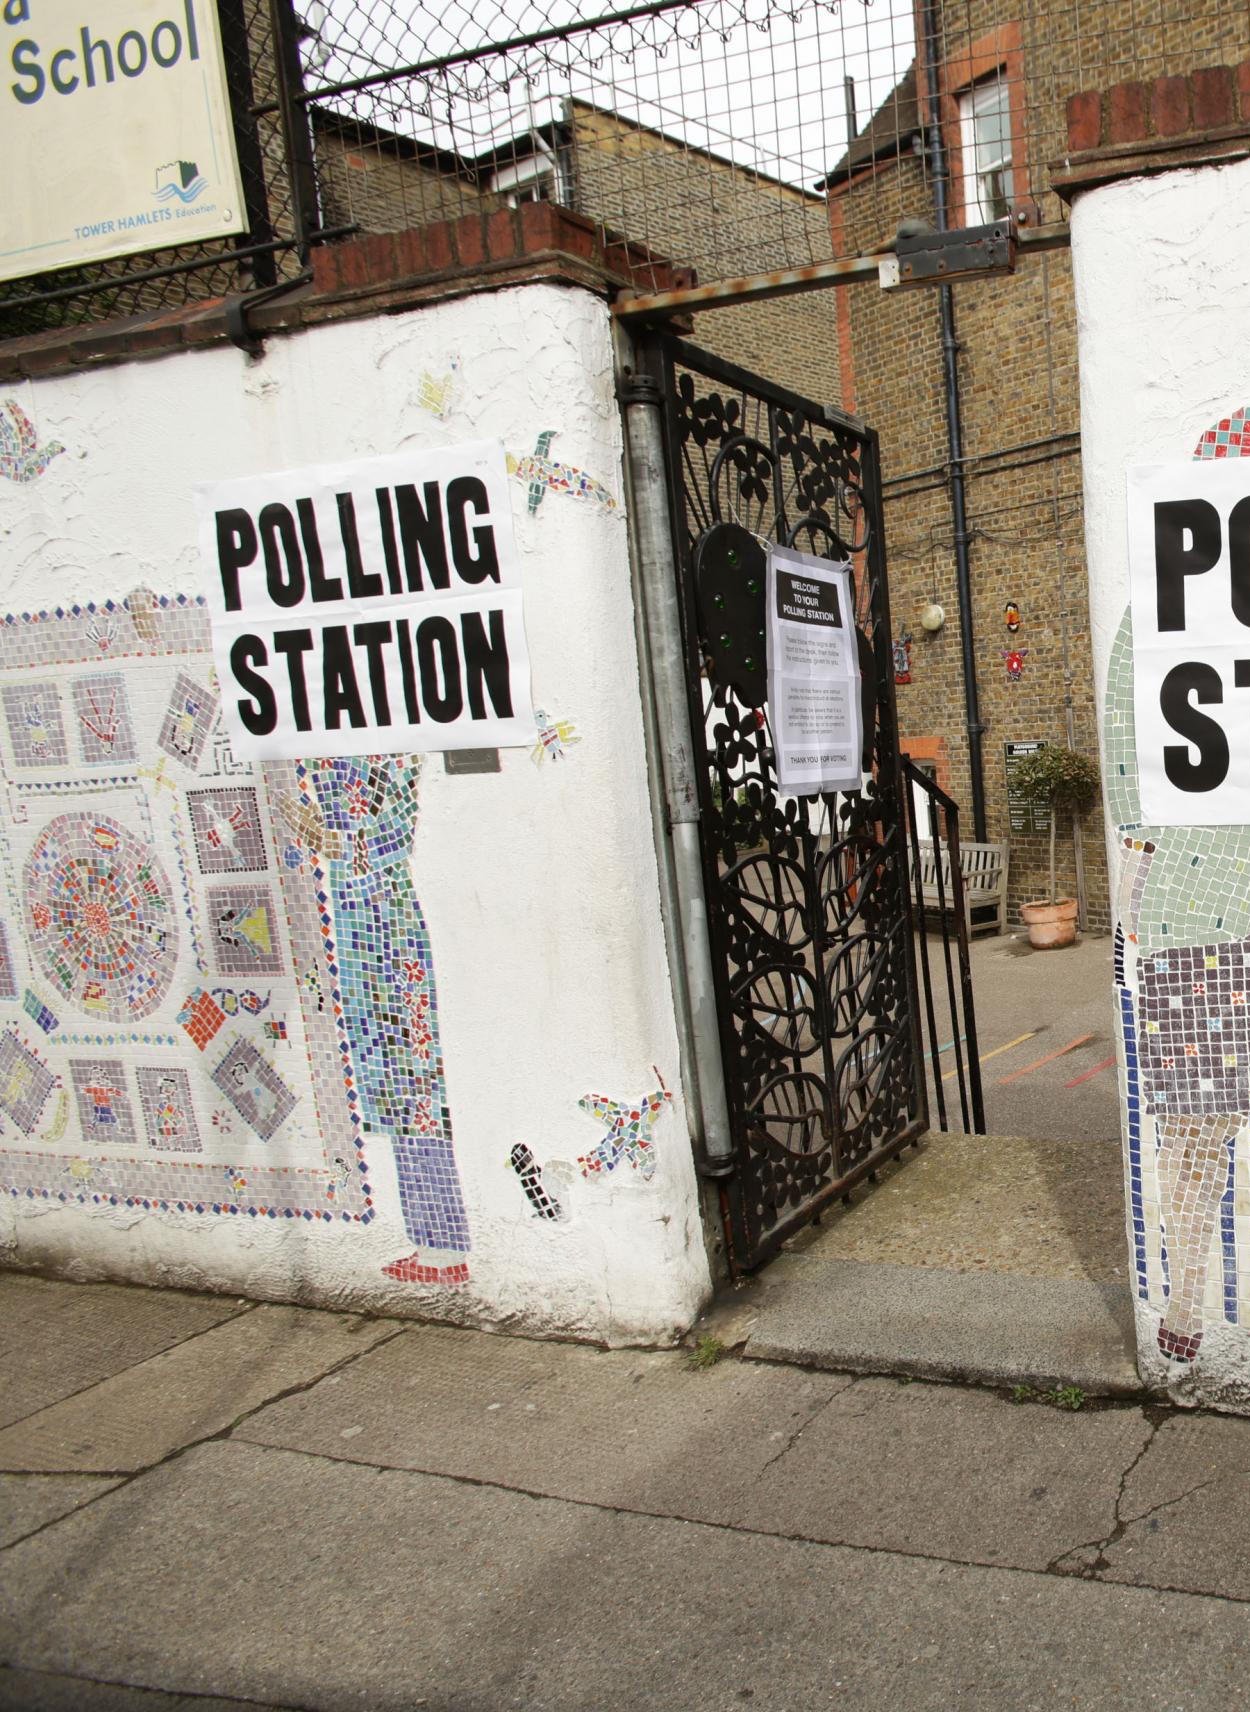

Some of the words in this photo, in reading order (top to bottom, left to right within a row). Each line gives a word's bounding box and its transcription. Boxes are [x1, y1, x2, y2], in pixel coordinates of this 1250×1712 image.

[11, 0, 200, 105] School
[74, 221, 115, 240] TOWER
[117, 207, 172, 231] HAMLETS
[175, 203, 216, 219] Education
[214, 475, 502, 613] POLLING
[790, 580, 820, 594] WELCOME
[793, 593, 801, 604] TO
[802, 596, 819, 607] YOUR
[783, 604, 806, 618] POLLING
[807, 609, 835, 622] STATION
[229, 609, 515, 737] STATION
